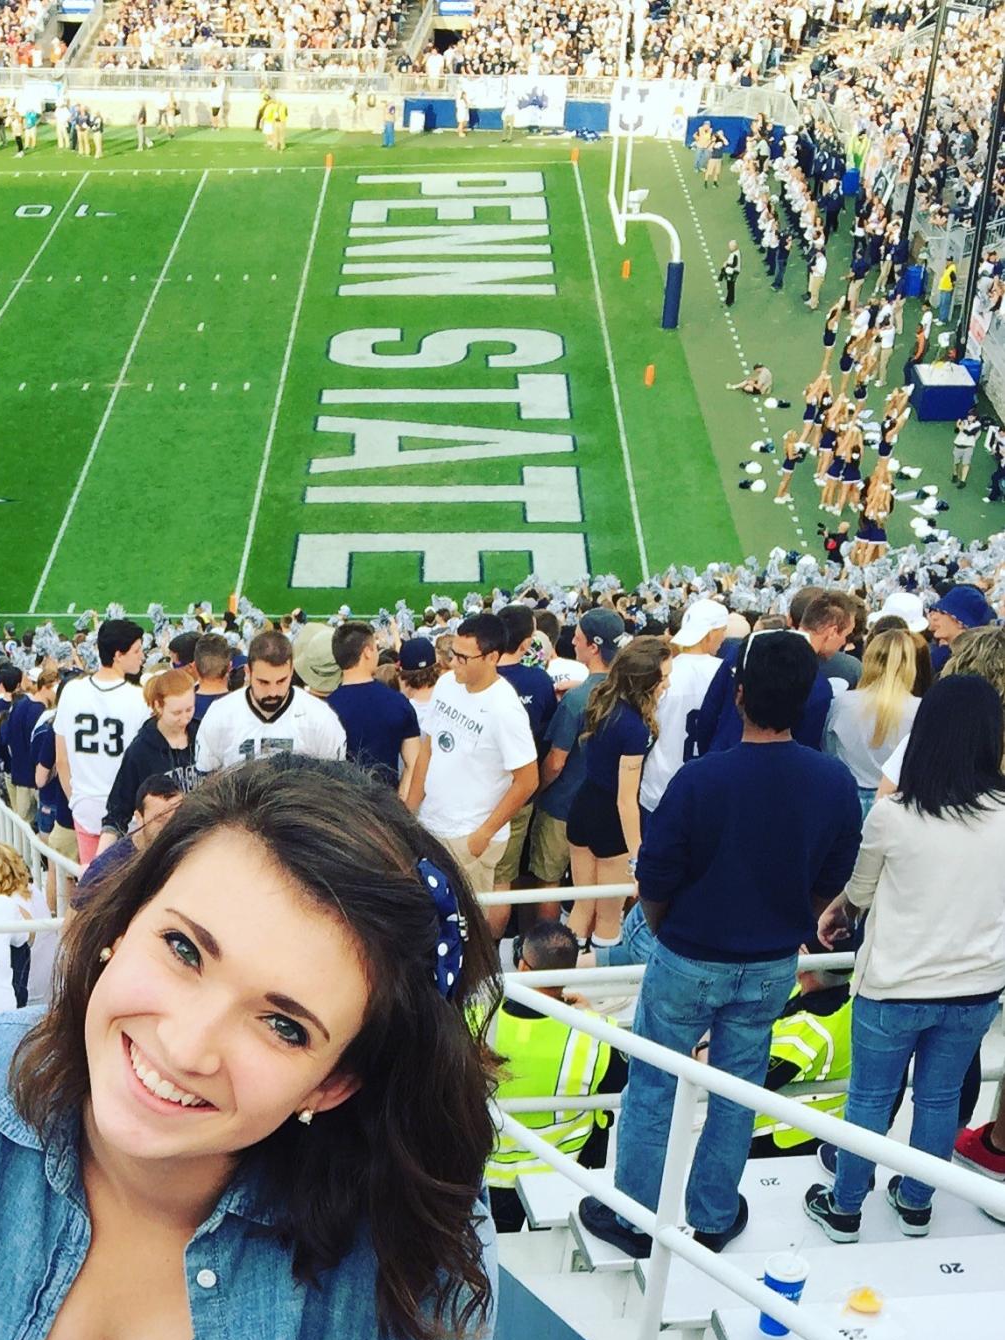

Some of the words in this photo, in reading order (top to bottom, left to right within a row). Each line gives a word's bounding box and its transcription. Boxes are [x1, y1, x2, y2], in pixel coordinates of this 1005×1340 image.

[15, 204, 91, 219] 10
[337, 171, 557, 296] PENN
[289, 327, 591, 589] STATE
[74, 713, 124, 757] 23
[435, 699, 483, 735] TRADITION
[939, 1262, 965, 1274] 20
